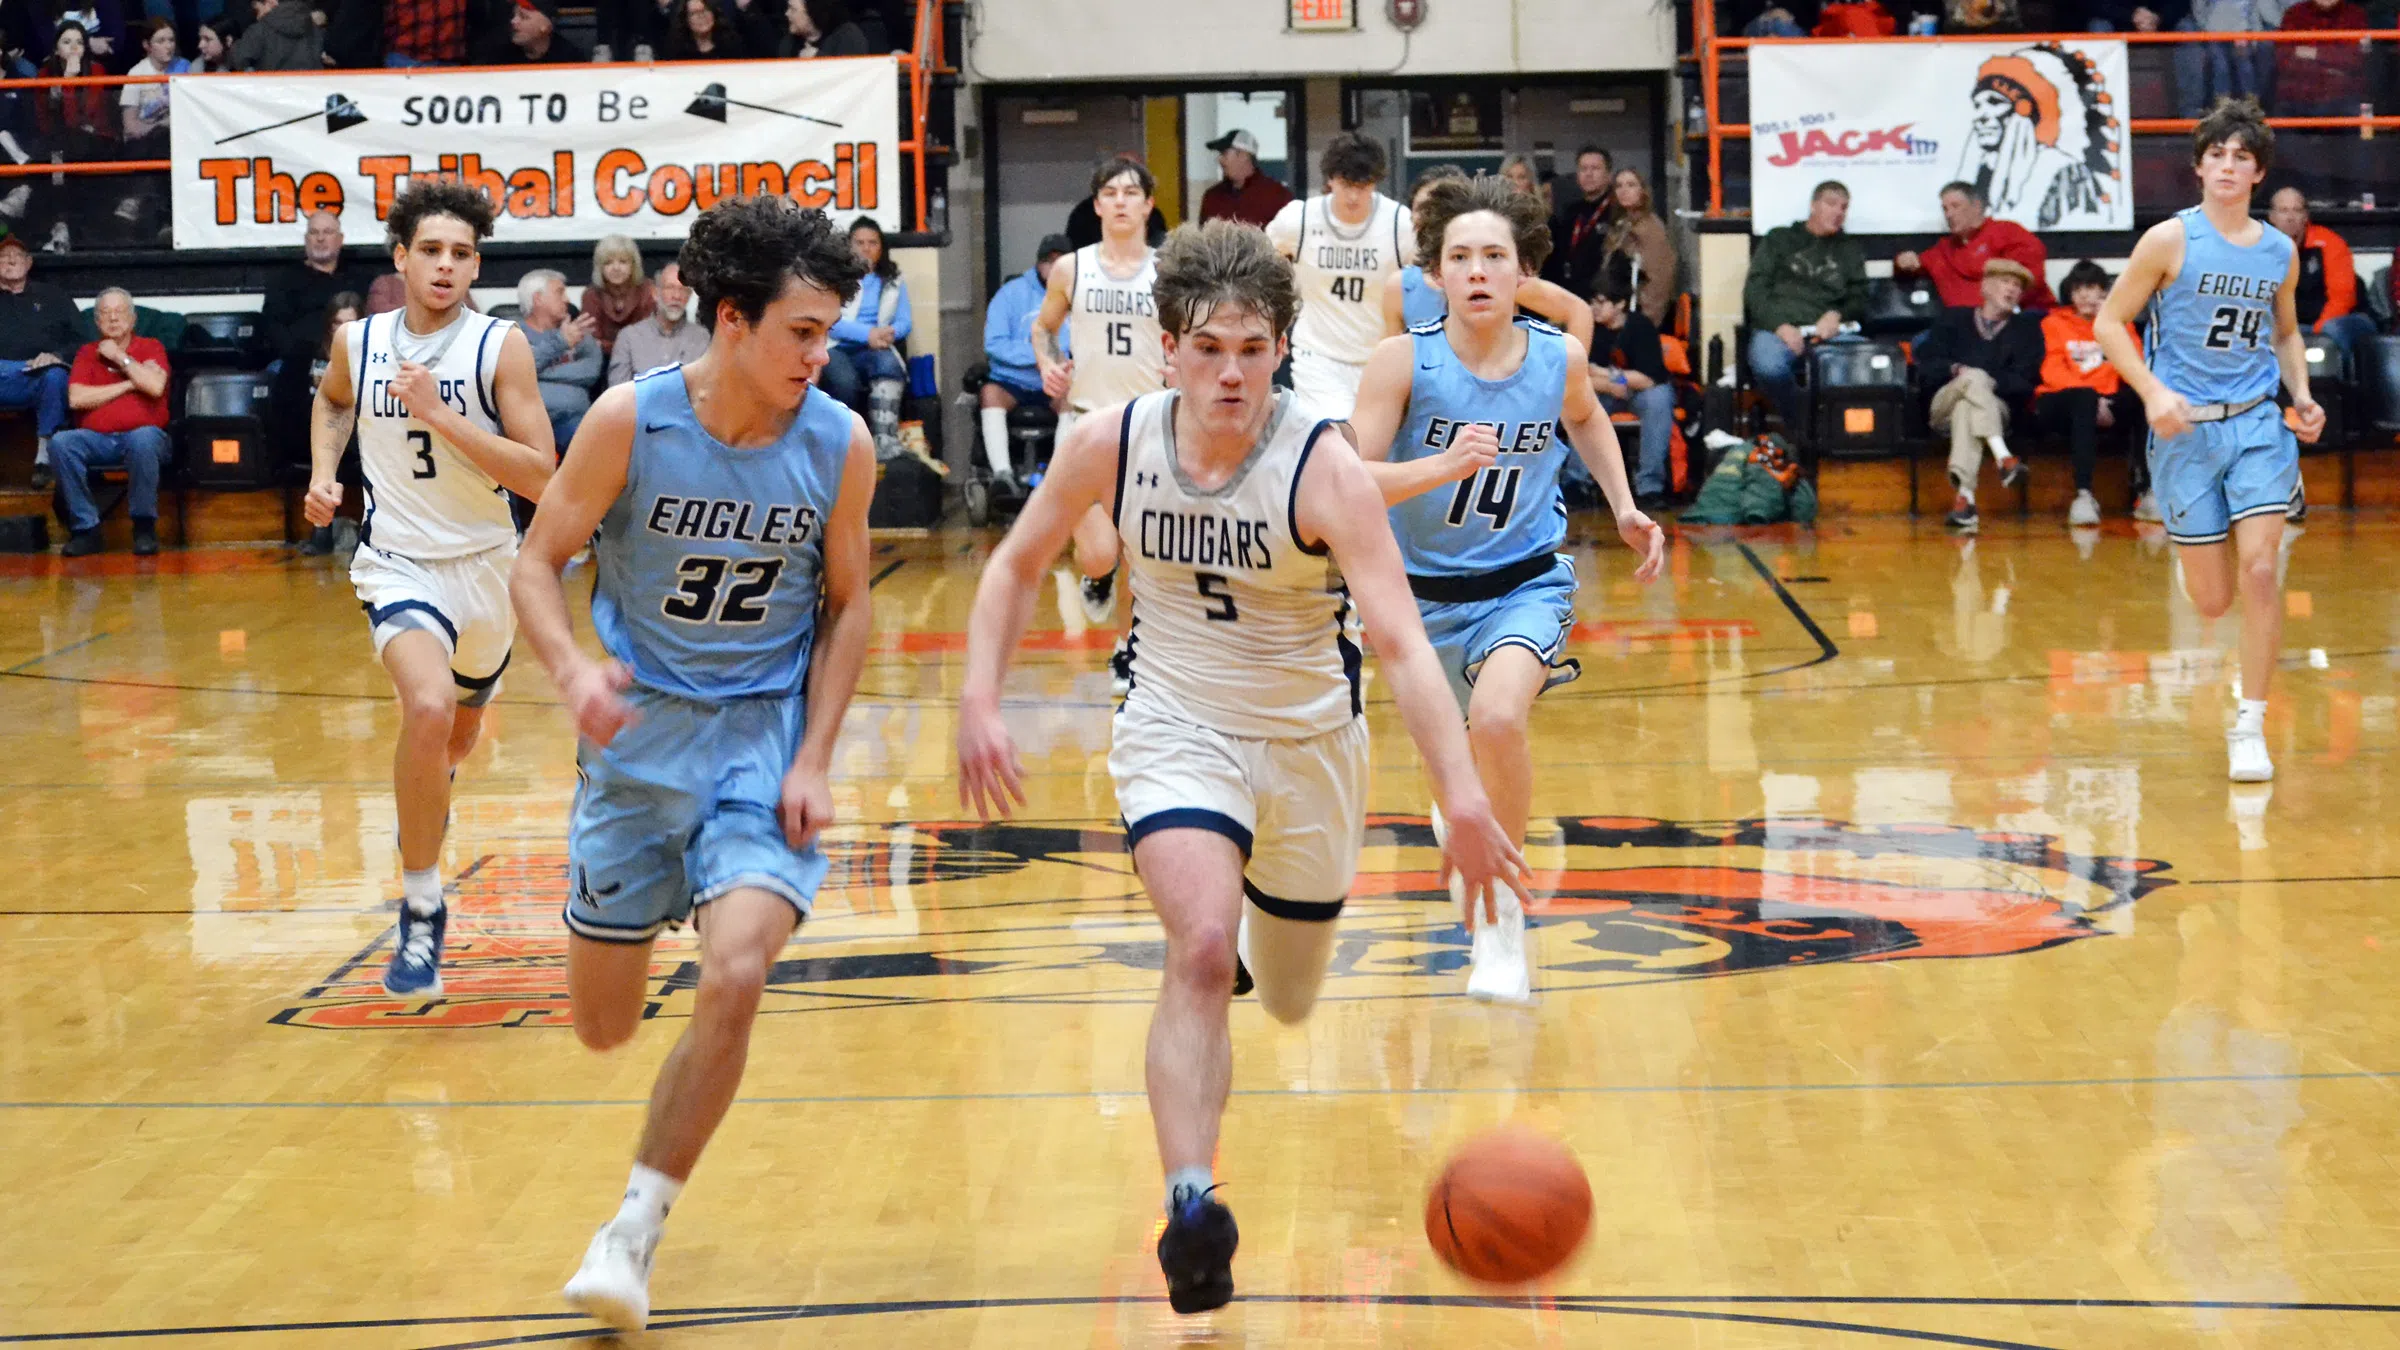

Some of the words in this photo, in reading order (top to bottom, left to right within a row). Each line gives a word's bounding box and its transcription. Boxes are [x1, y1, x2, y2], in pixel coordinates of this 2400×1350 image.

[519, 93, 567, 124] TO
[597, 90, 648, 122] Be
[1768, 121, 1916, 167] JACK
[199, 157, 344, 225] The
[594, 142, 878, 217] Council
[1318, 246, 1378, 271] COUGARS
[1086, 288, 1153, 317] COUGARS
[1331, 275, 1365, 303] 40
[1107, 322, 1132, 356] 15
[2204, 304, 2264, 351] 24
[373, 380, 466, 417] CORS
[407, 430, 436, 479] 3
[1424, 416, 1553, 454] ELES
[648, 495, 817, 545] EAGLES
[1445, 466, 1523, 532] 14
[1141, 509, 1272, 570] COUGARS
[661, 555, 787, 625] 32
[1195, 571, 1238, 621] 5
